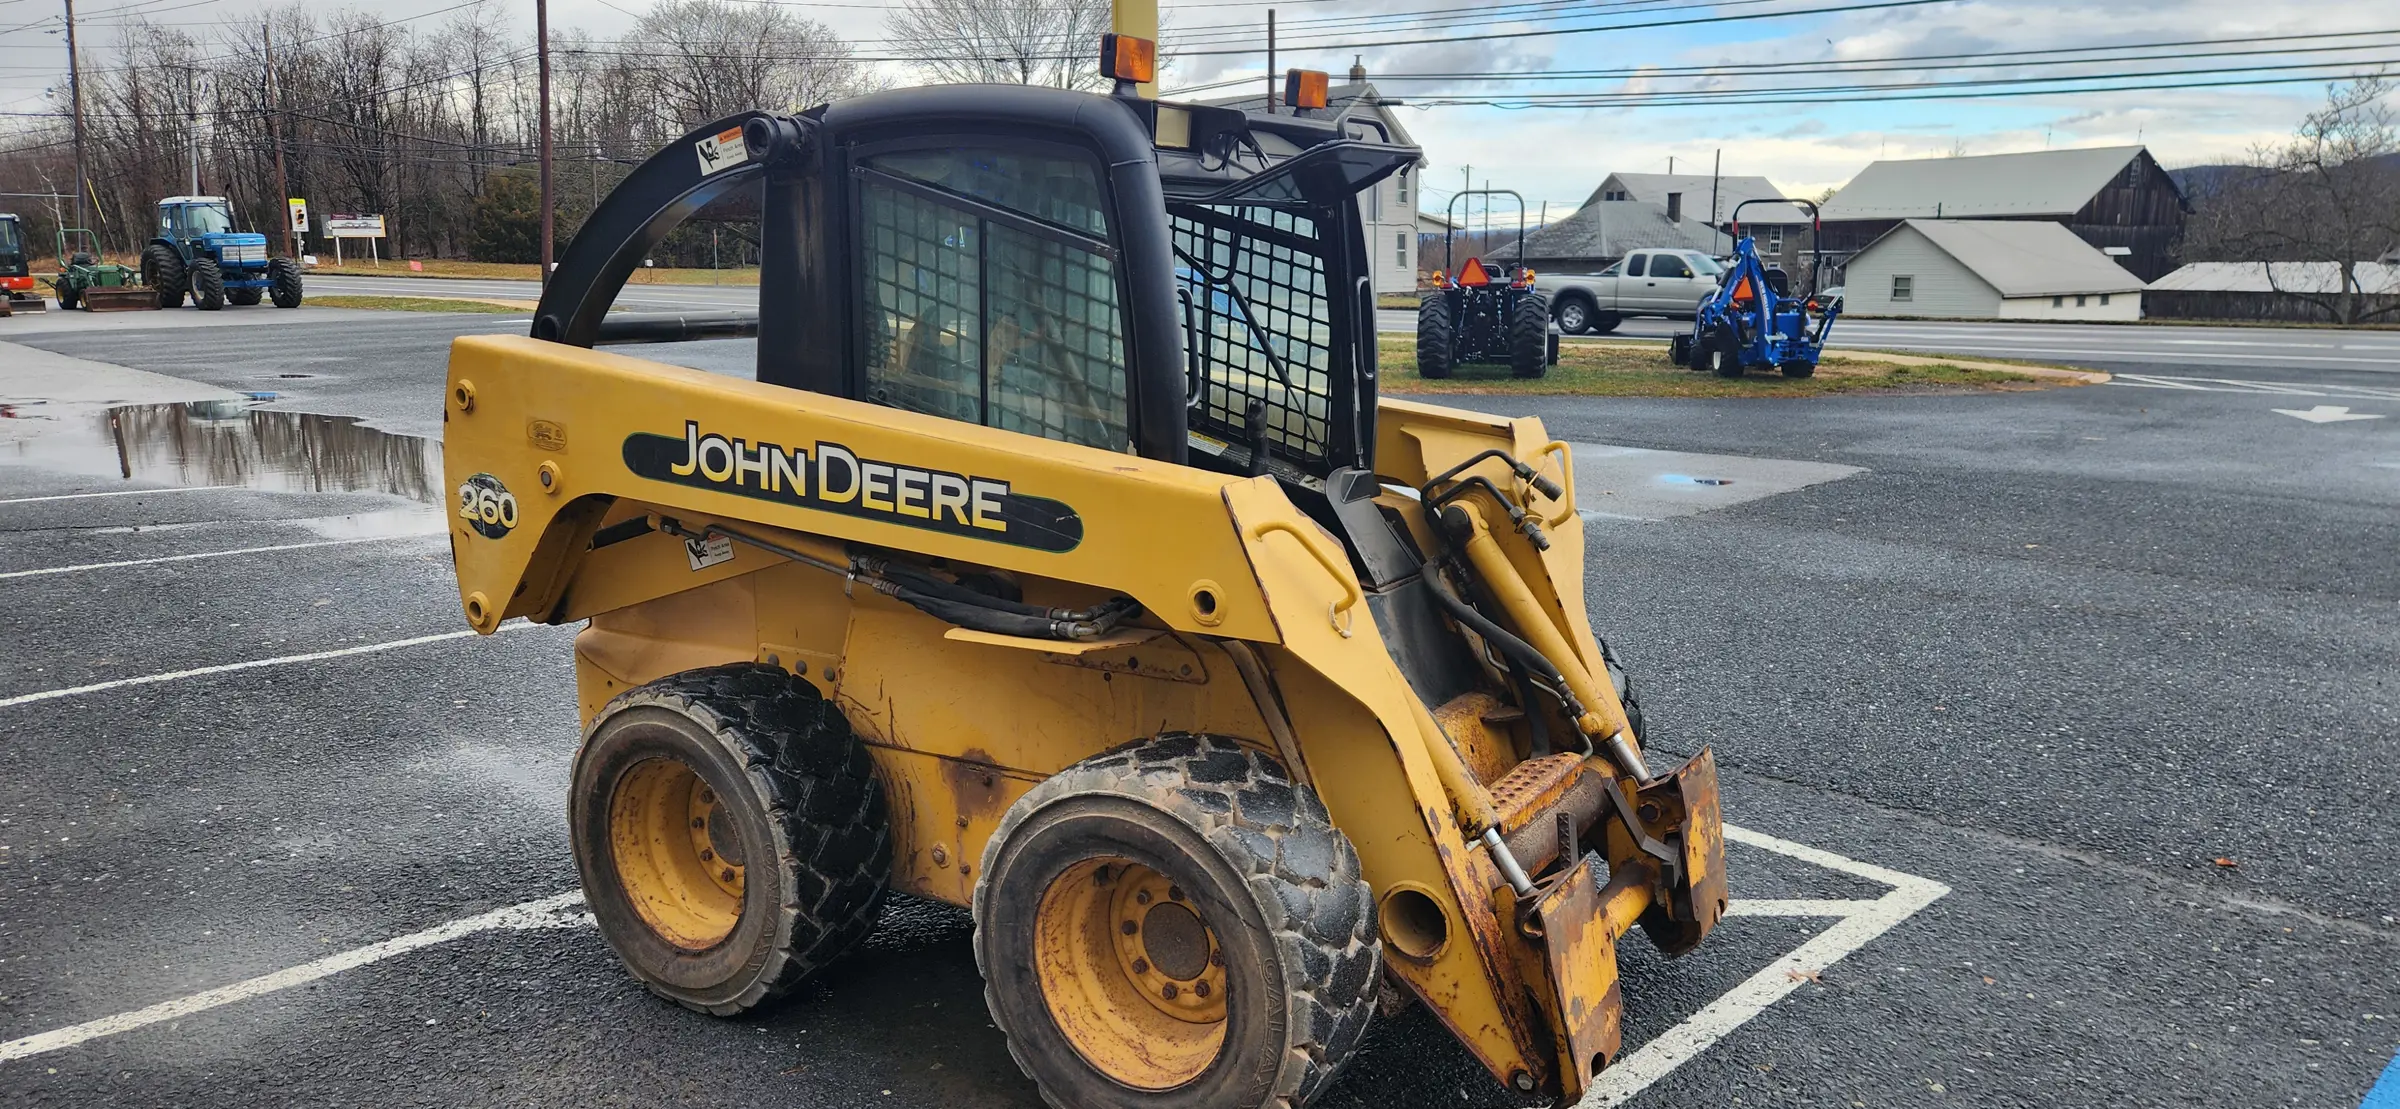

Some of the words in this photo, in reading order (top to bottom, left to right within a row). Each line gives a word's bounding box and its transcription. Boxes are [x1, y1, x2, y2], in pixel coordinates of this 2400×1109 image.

[459, 484, 519, 529] 260
[669, 421, 807, 498] JOHN
[816, 442, 1008, 533] DEERE
